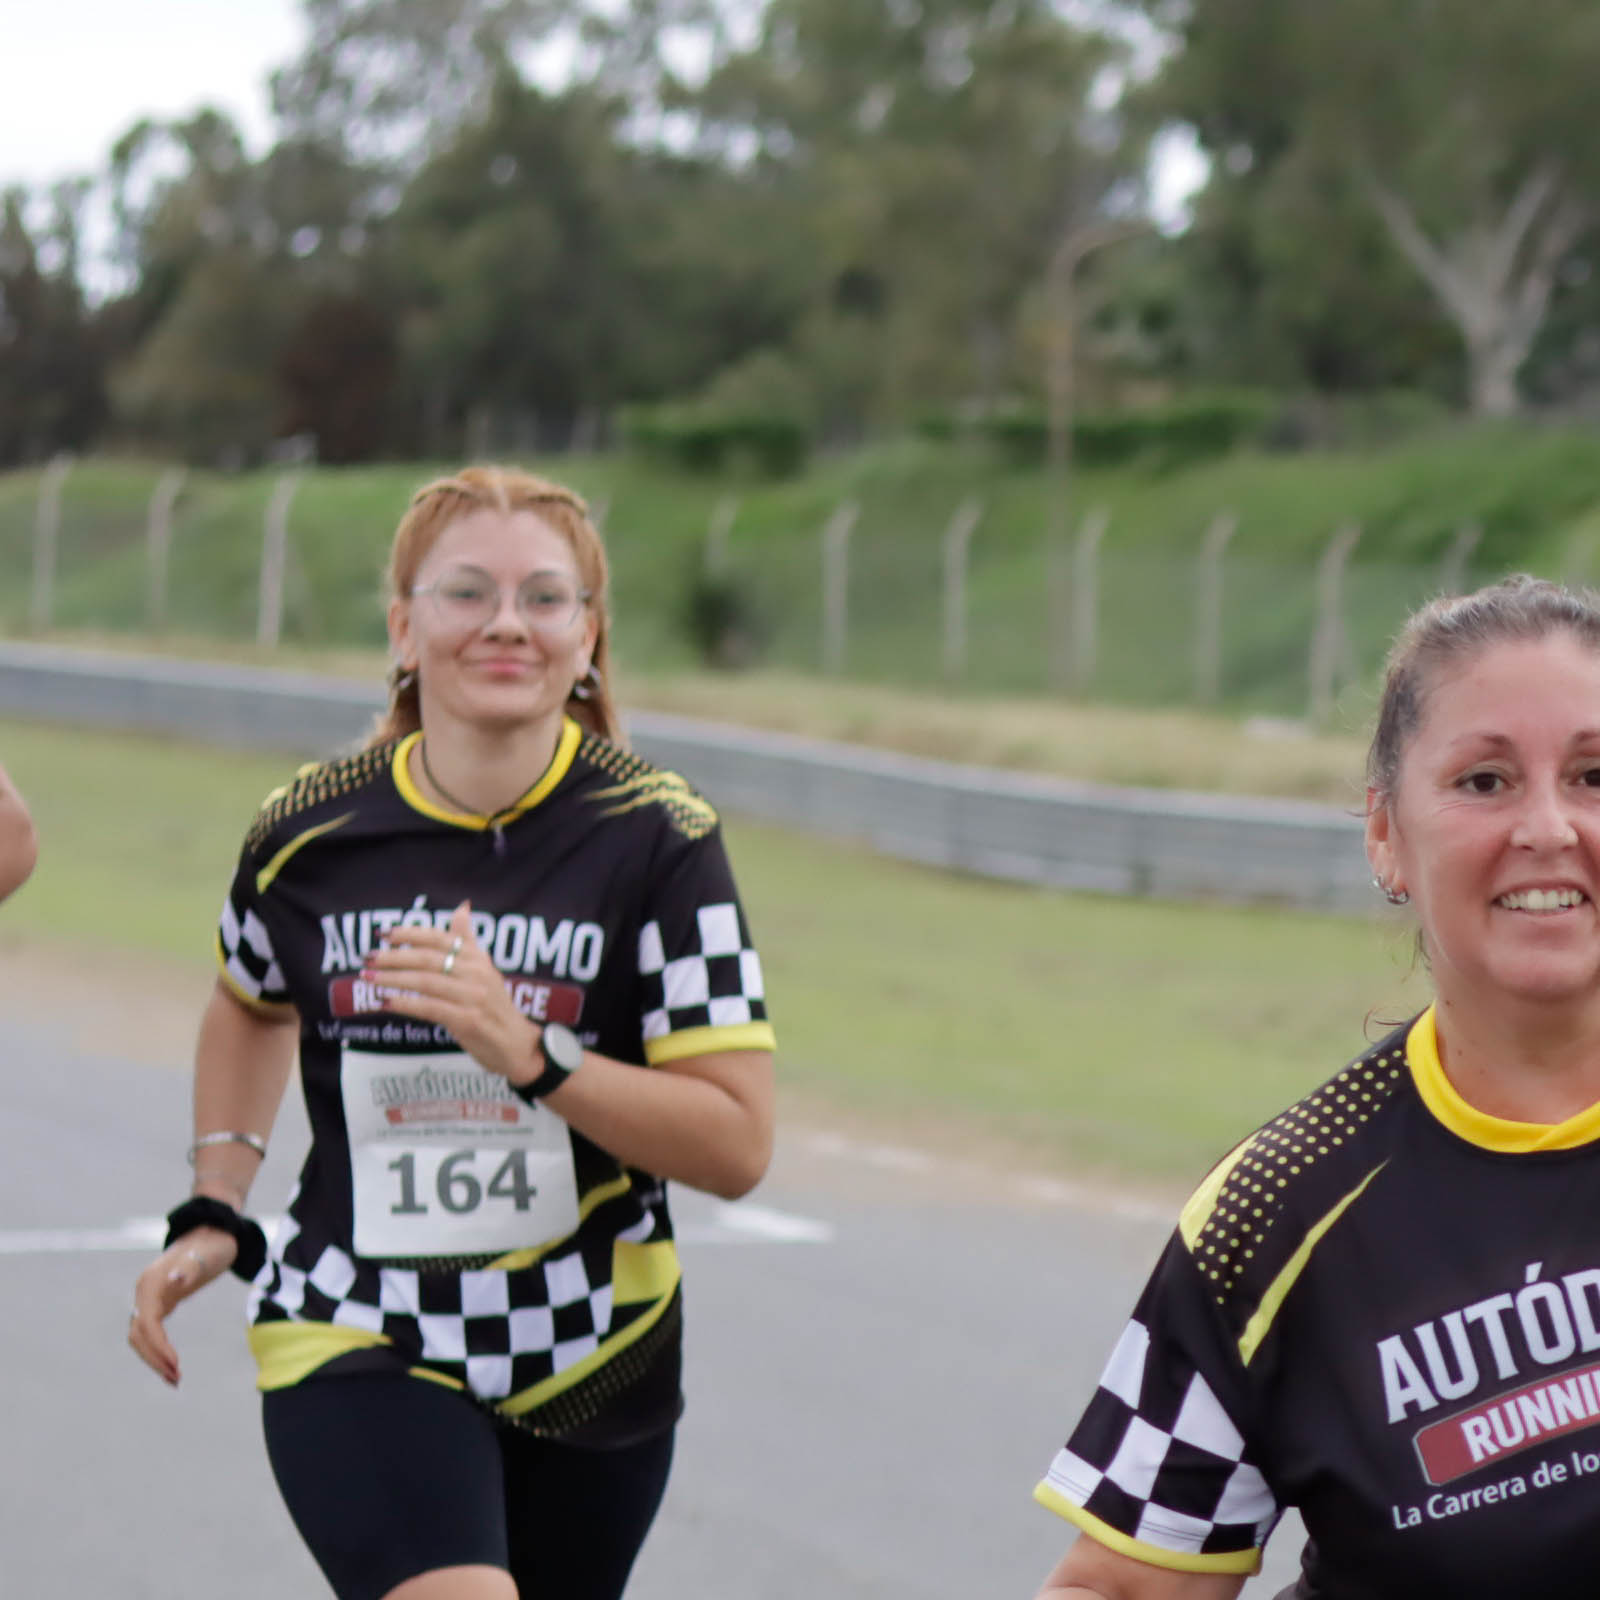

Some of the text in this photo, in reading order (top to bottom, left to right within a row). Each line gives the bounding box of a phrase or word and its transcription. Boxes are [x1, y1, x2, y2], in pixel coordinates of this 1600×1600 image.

[388, 1149, 538, 1214] 164
[1392, 1503, 1423, 1530] La
[1426, 1476, 1528, 1521] Carrera
[1532, 1460, 1568, 1489] de
